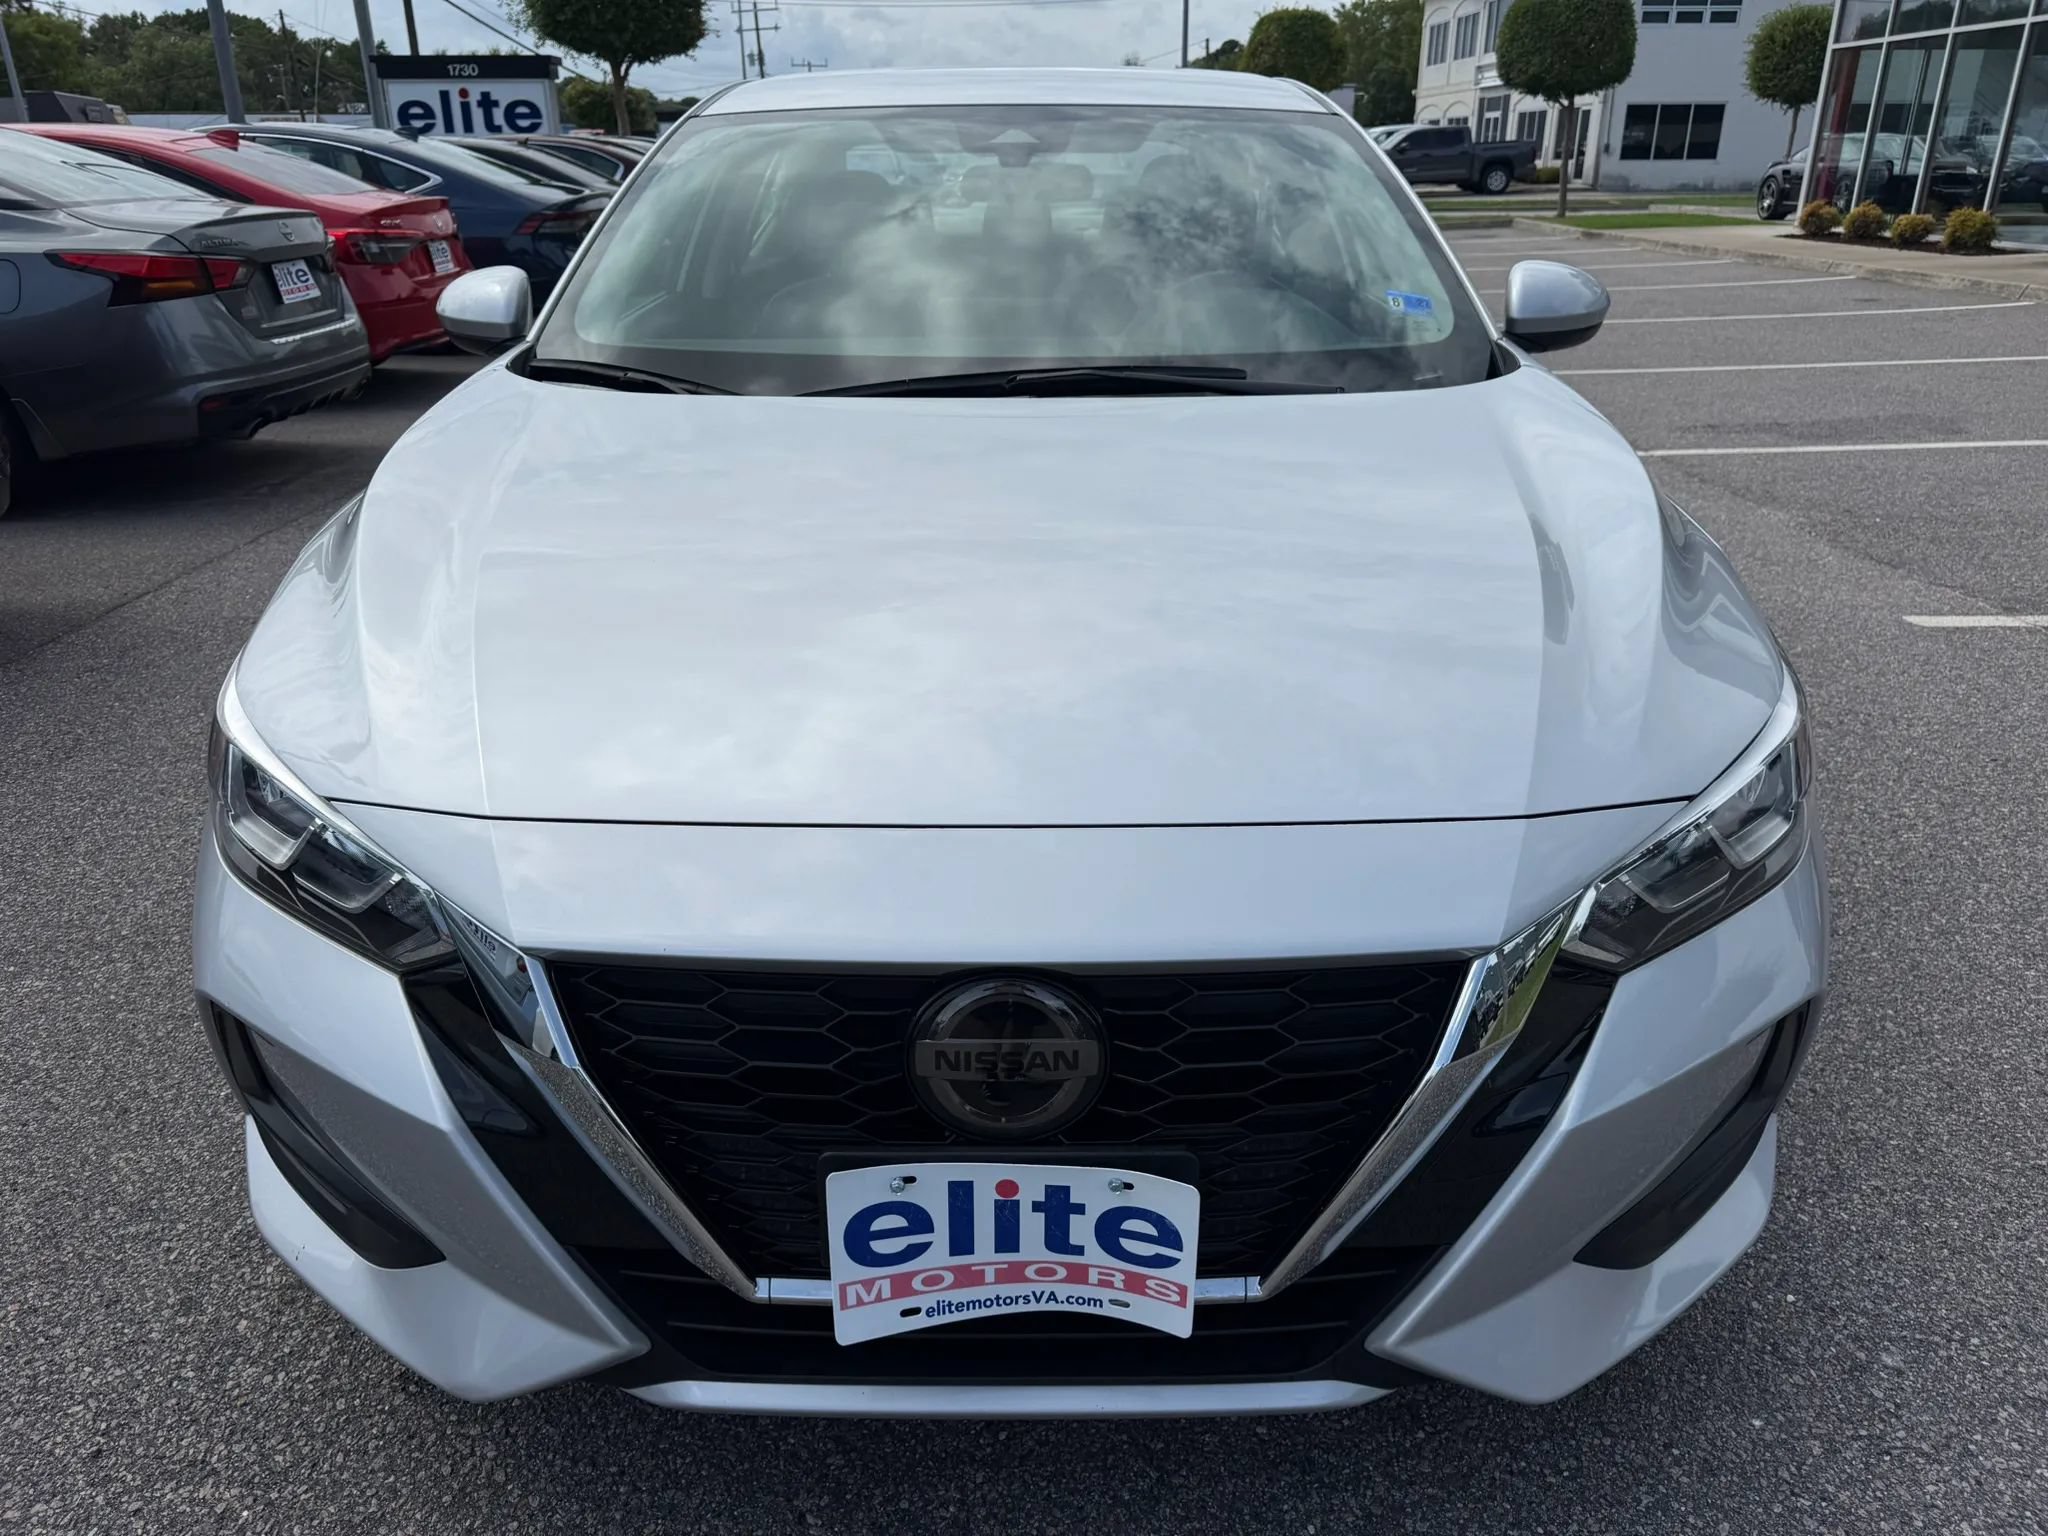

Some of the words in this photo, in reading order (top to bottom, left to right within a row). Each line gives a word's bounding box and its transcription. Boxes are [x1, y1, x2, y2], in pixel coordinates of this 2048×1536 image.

[447, 63, 479, 77] 1730
[397, 87, 543, 135] elite
[934, 1050, 1080, 1073] NISSAN
[843, 1178, 1184, 1270] elite
[845, 1263, 1182, 1306] MOTORS
[924, 1290, 1104, 1318] elitemotorsVA.com
